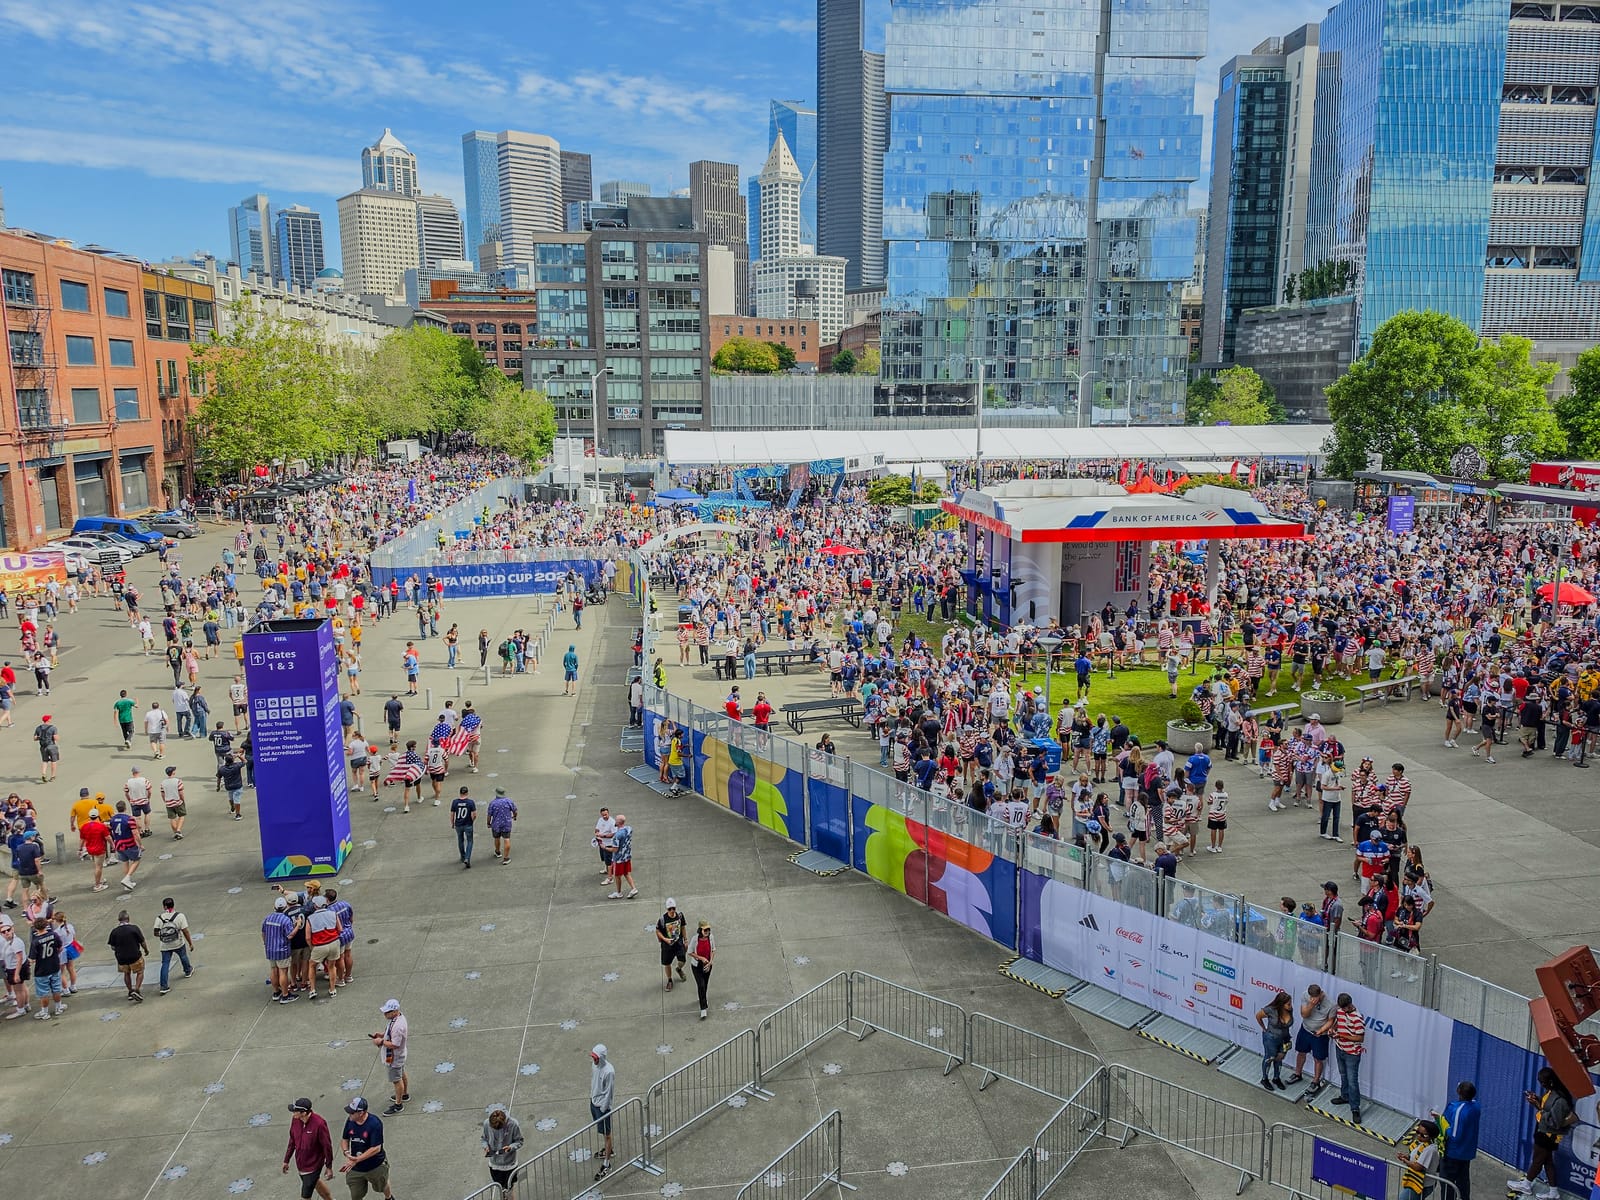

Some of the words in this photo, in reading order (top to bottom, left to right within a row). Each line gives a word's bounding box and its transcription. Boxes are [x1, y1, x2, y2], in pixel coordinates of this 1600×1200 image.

[441, 577, 458, 587] IFA
[460, 574, 506, 586] WORLD
[508, 573, 533, 583] CUP
[534, 571, 568, 582] 202
[267, 651, 297, 659] Gates
[268, 663, 274, 671] 1
[288, 662, 295, 670] 3
[432, 754, 438, 764] 8
[457, 807, 468, 819] 10
[1217, 800, 1225, 812] 5
[1013, 811, 1023, 823] 10
[115, 823, 122, 836] 4
[42, 941, 55, 959] 16
[1203, 960, 1235, 977] aramco
[1251, 976, 1286, 993] Lenovo
[1320, 1146, 1342, 1159] Please
[1342, 1155, 1358, 1166] wait
[1358, 1160, 1375, 1171] here
[1570, 1162, 1596, 1179] WOR
[1569, 1171, 1594, 1190] 20
